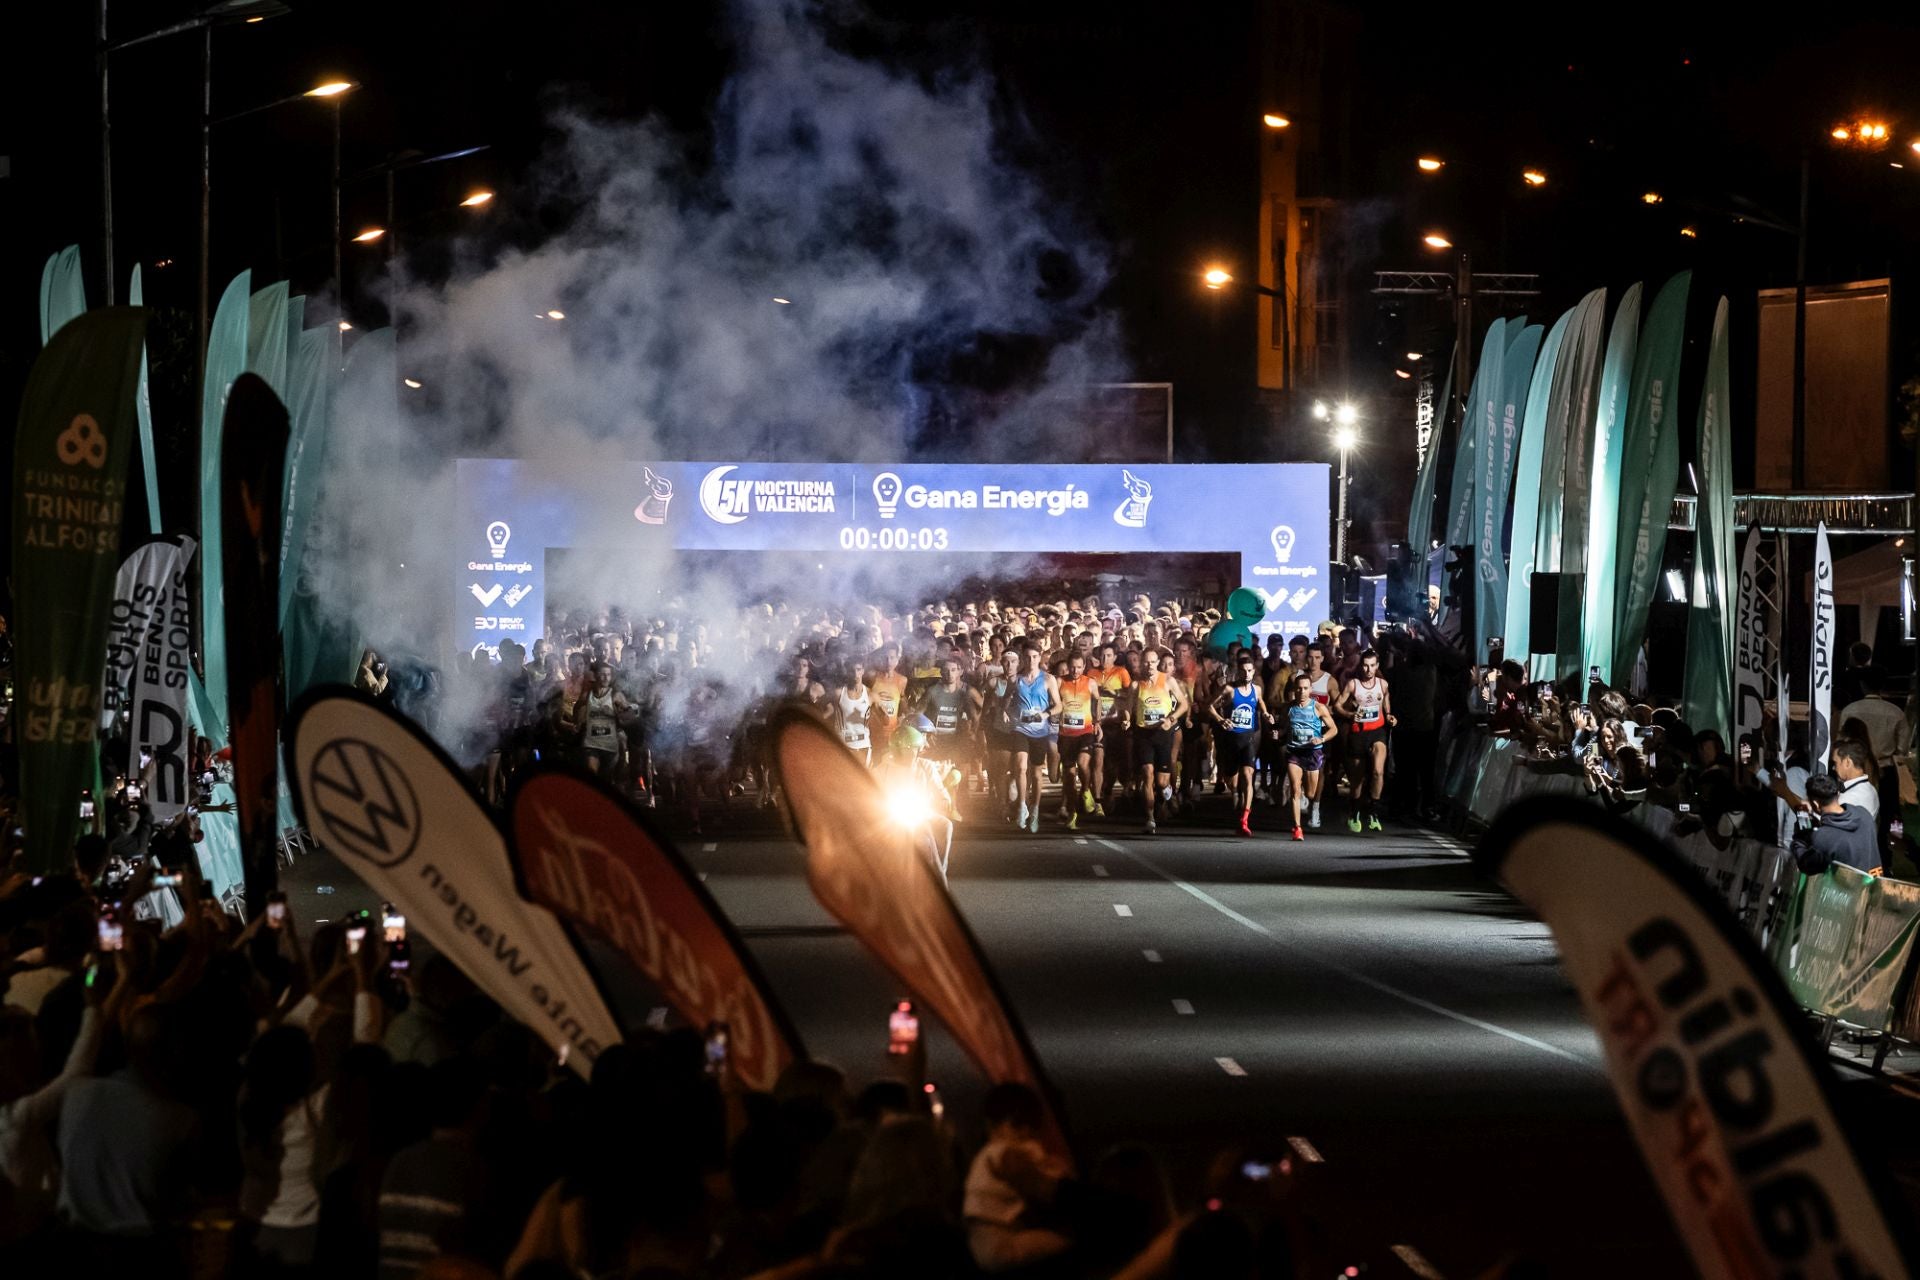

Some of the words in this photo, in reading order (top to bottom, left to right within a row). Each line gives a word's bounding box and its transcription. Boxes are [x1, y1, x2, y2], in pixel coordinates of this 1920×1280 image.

[720, 480, 754, 514] 5K
[754, 480, 836, 497] NOCTURNA
[754, 496, 836, 513] VALENCIA
[904, 484, 978, 509] Gana
[982, 484, 1089, 516] Energía
[839, 527, 949, 551] 00:00:03
[1482, 495, 1494, 557] Gana
[467, 561, 494, 571] Gana
[494, 561, 533, 574] Energía
[1253, 565, 1279, 576] Gana
[164, 569, 190, 690] SPORTS
[1739, 570, 1753, 671] BENJO
[1815, 560, 1834, 692] SPORTS
